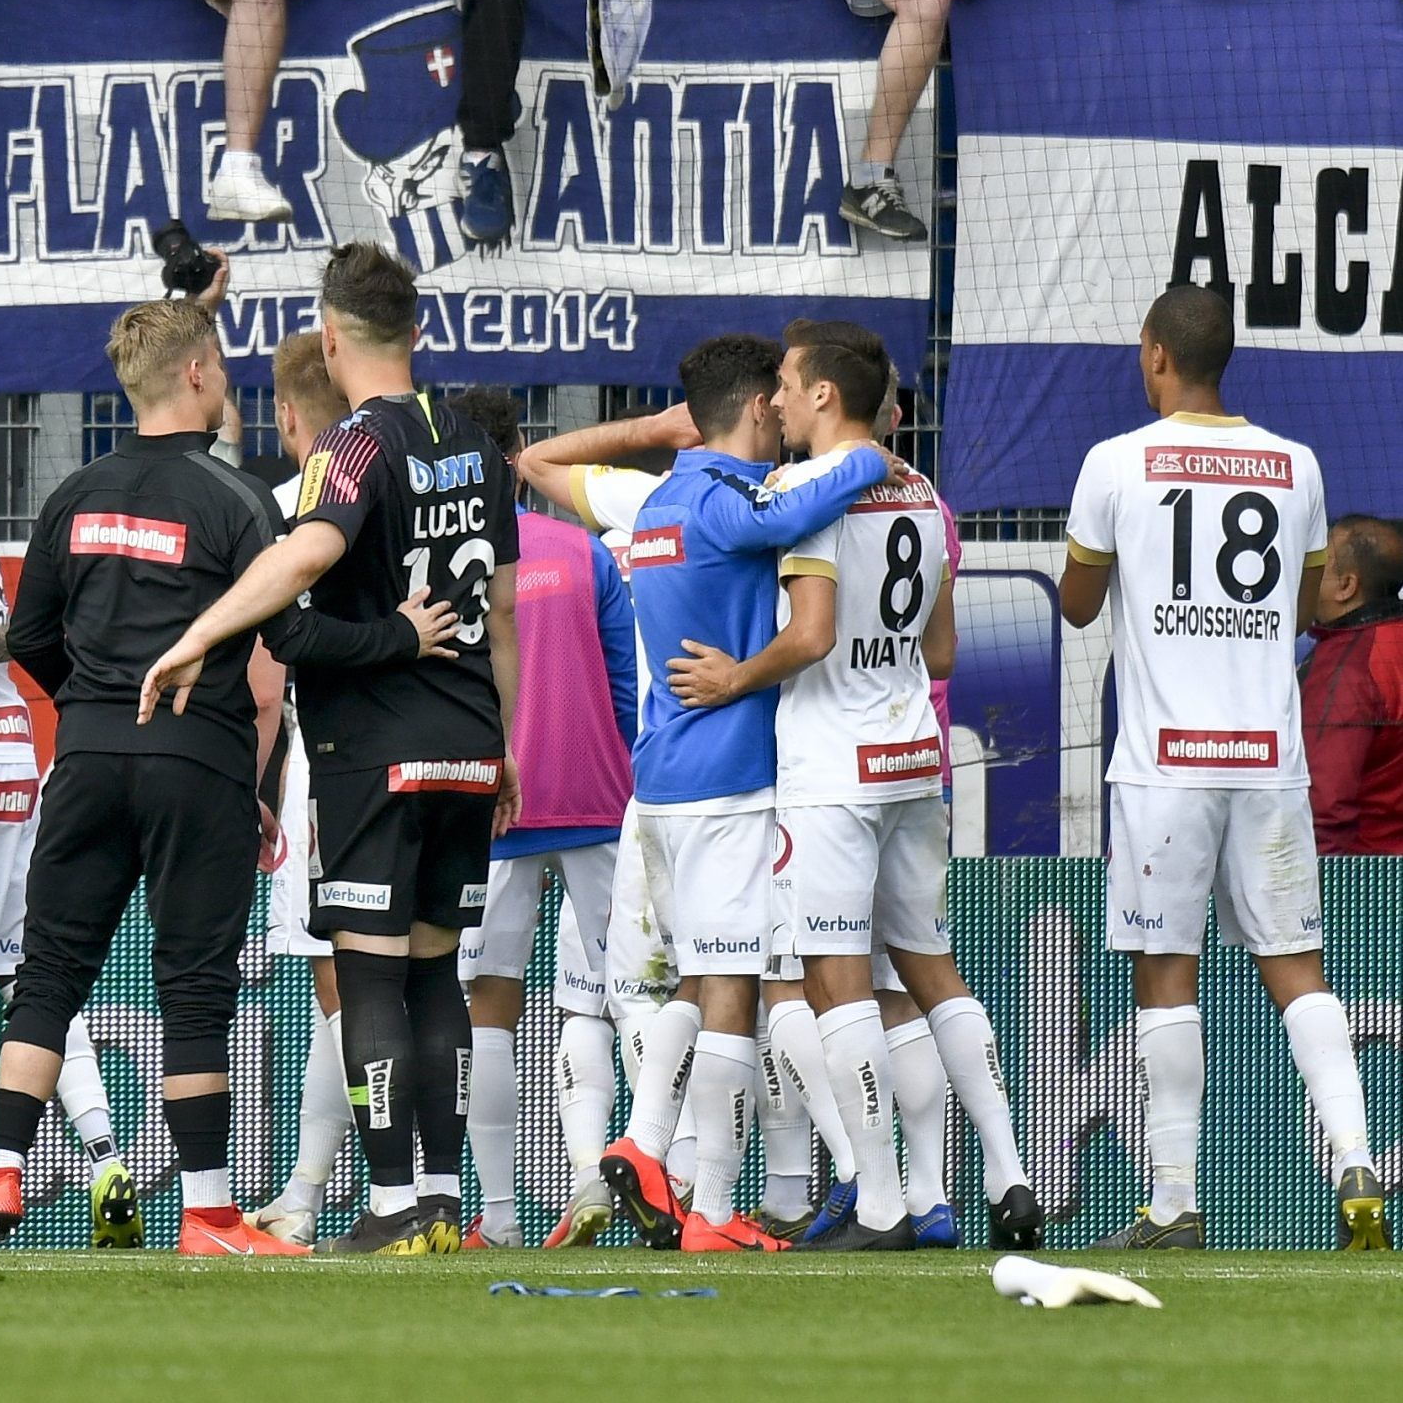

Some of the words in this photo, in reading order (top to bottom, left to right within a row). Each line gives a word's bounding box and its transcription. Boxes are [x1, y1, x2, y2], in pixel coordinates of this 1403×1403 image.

[214, 289, 459, 359] VIEA
[462, 288, 638, 353] 2014
[1184, 454, 1287, 481] GENERALI
[414, 497, 487, 539] LUCIC
[1158, 488, 1282, 605] 18
[880, 516, 925, 633] 8
[1153, 604, 1281, 642] SCHOISSENGEYR
[850, 636, 922, 670] MATI
[322, 887, 386, 905] Verbund
[692, 936, 761, 954] Verbund
[806, 914, 871, 933] Verbund
[563, 969, 606, 995] Verbun
[371, 1060, 389, 1115] KANDL
[460, 1051, 472, 1102] KANDL
[762, 1048, 781, 1098] KANDL
[780, 1049, 806, 1093] KANDL
[858, 1060, 880, 1116] KANDL
[733, 1087, 746, 1140] KANDL
